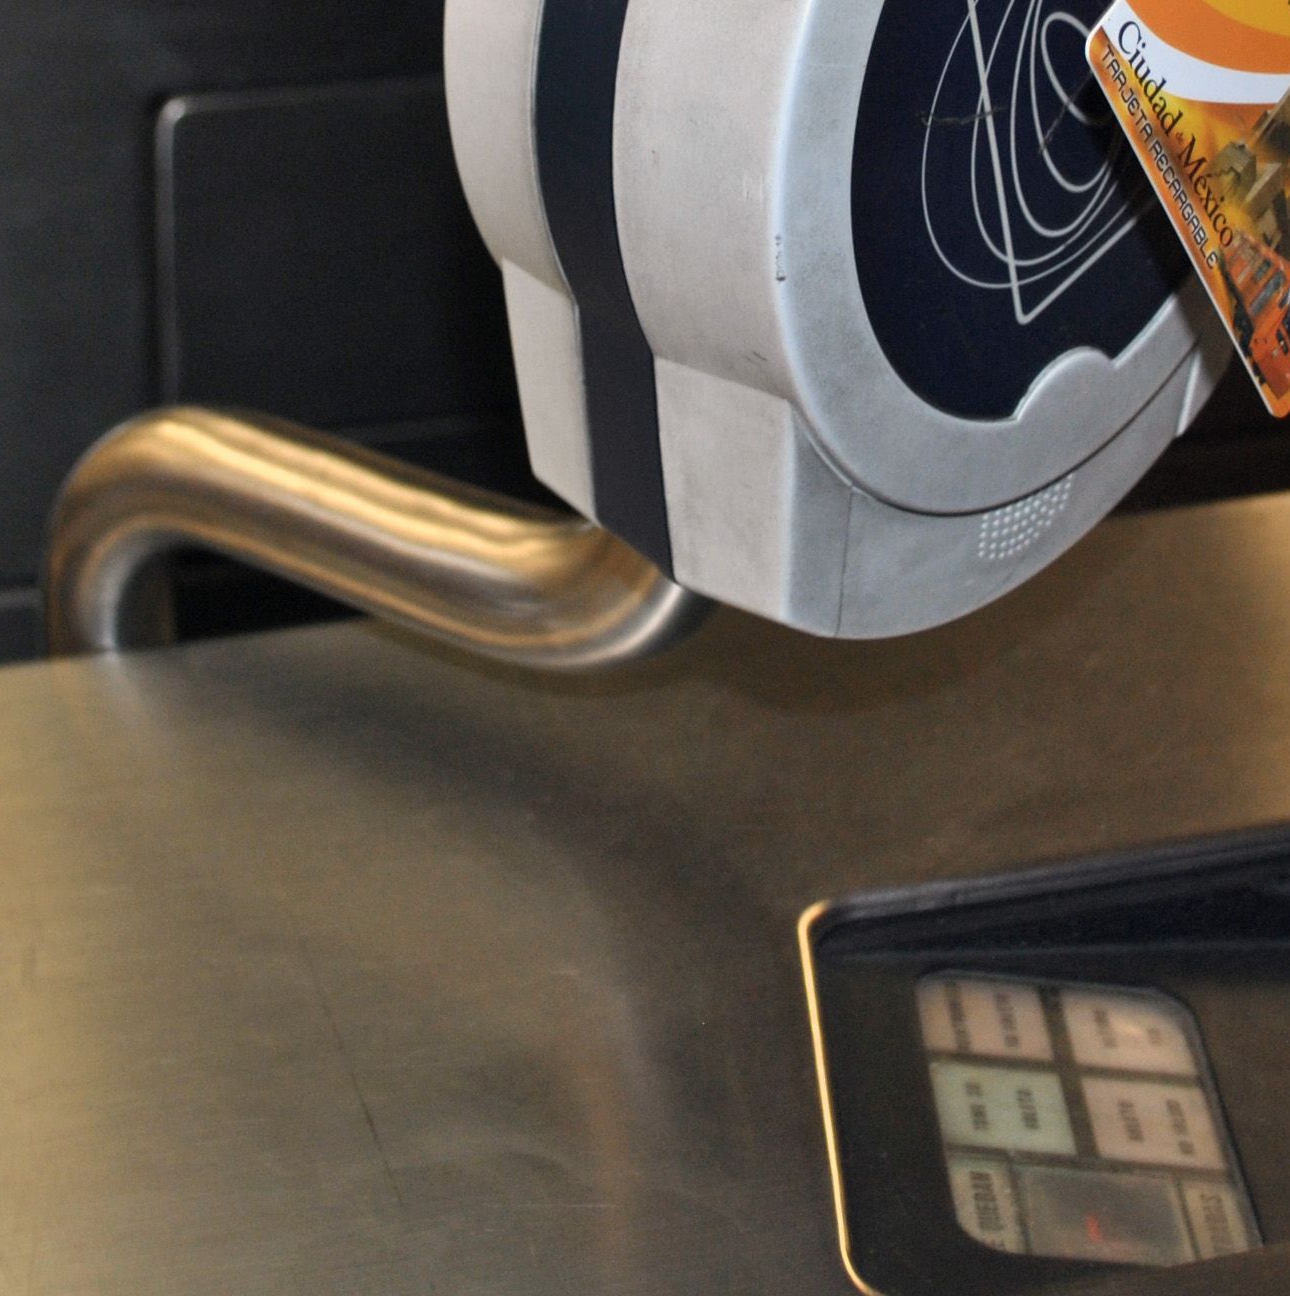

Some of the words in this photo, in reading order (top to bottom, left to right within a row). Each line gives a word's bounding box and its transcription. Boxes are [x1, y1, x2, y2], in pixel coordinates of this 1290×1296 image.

[1102, 44, 1153, 141] TARJETA
[1149, 139, 1220, 270] RECARGABLE
[1118, 20, 1183, 137] Ciudad
[1177, 135, 1234, 248] México
